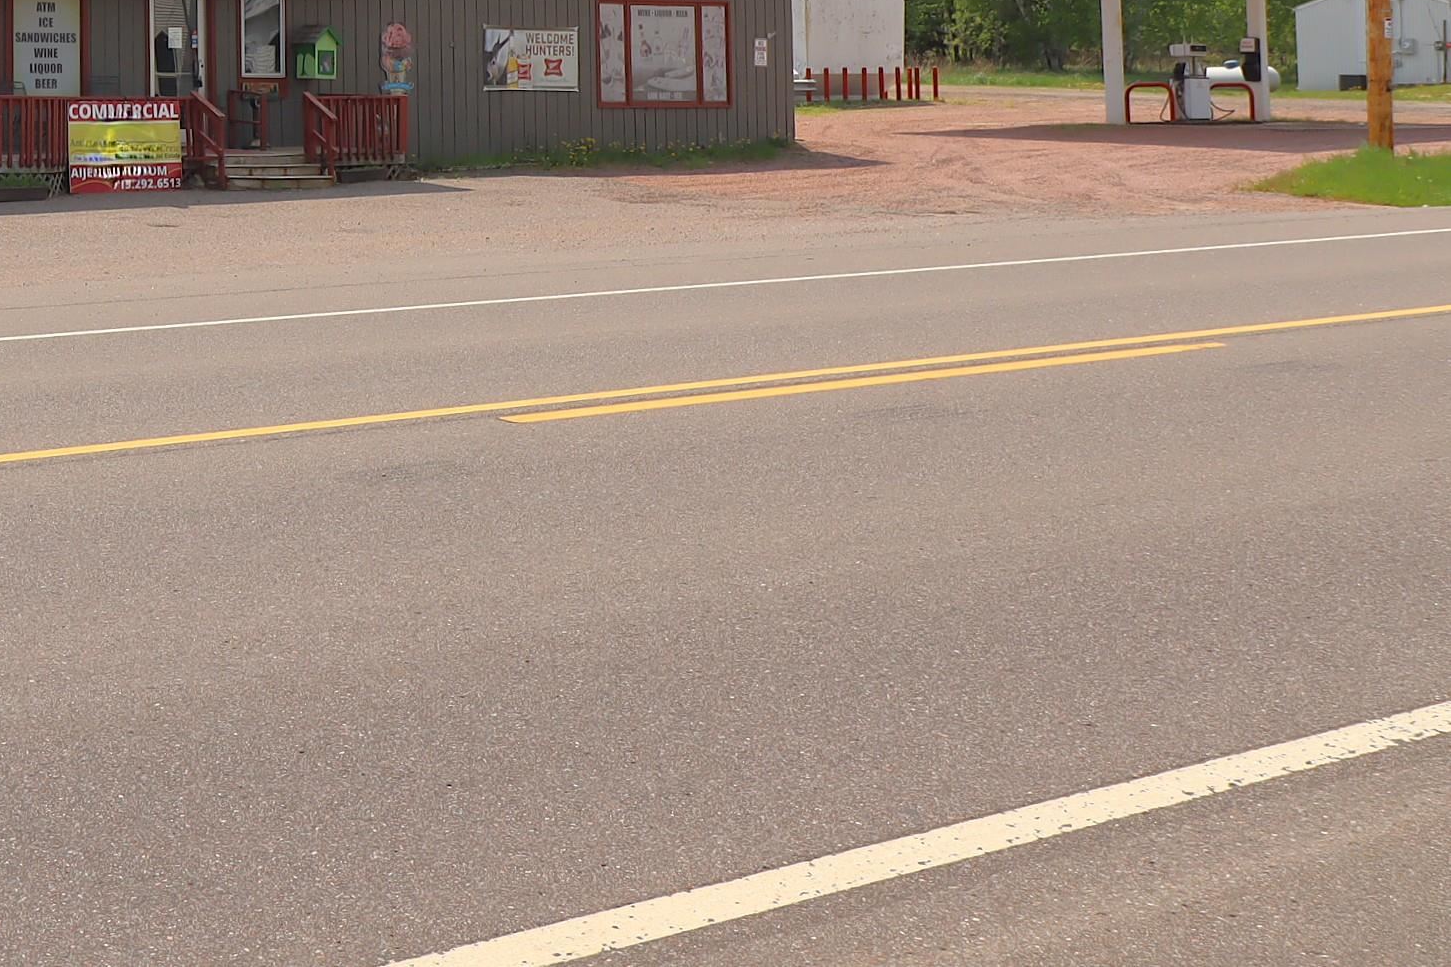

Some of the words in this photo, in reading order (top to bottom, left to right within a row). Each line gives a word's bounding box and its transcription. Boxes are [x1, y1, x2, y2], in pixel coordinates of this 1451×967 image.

[36, 1, 56, 13] ATM
[38, 17, 54, 28] ICE
[15, 32, 77, 44] SANDWICHES
[525, 32, 575, 44] WELCOME
[33, 48, 59, 59] WINE
[525, 45, 575, 57] HUNTERS!
[29, 63, 63, 74] LIQUOR
[35, 78, 58, 90] BEER
[68, 103, 179, 119] COMMERCIAL
